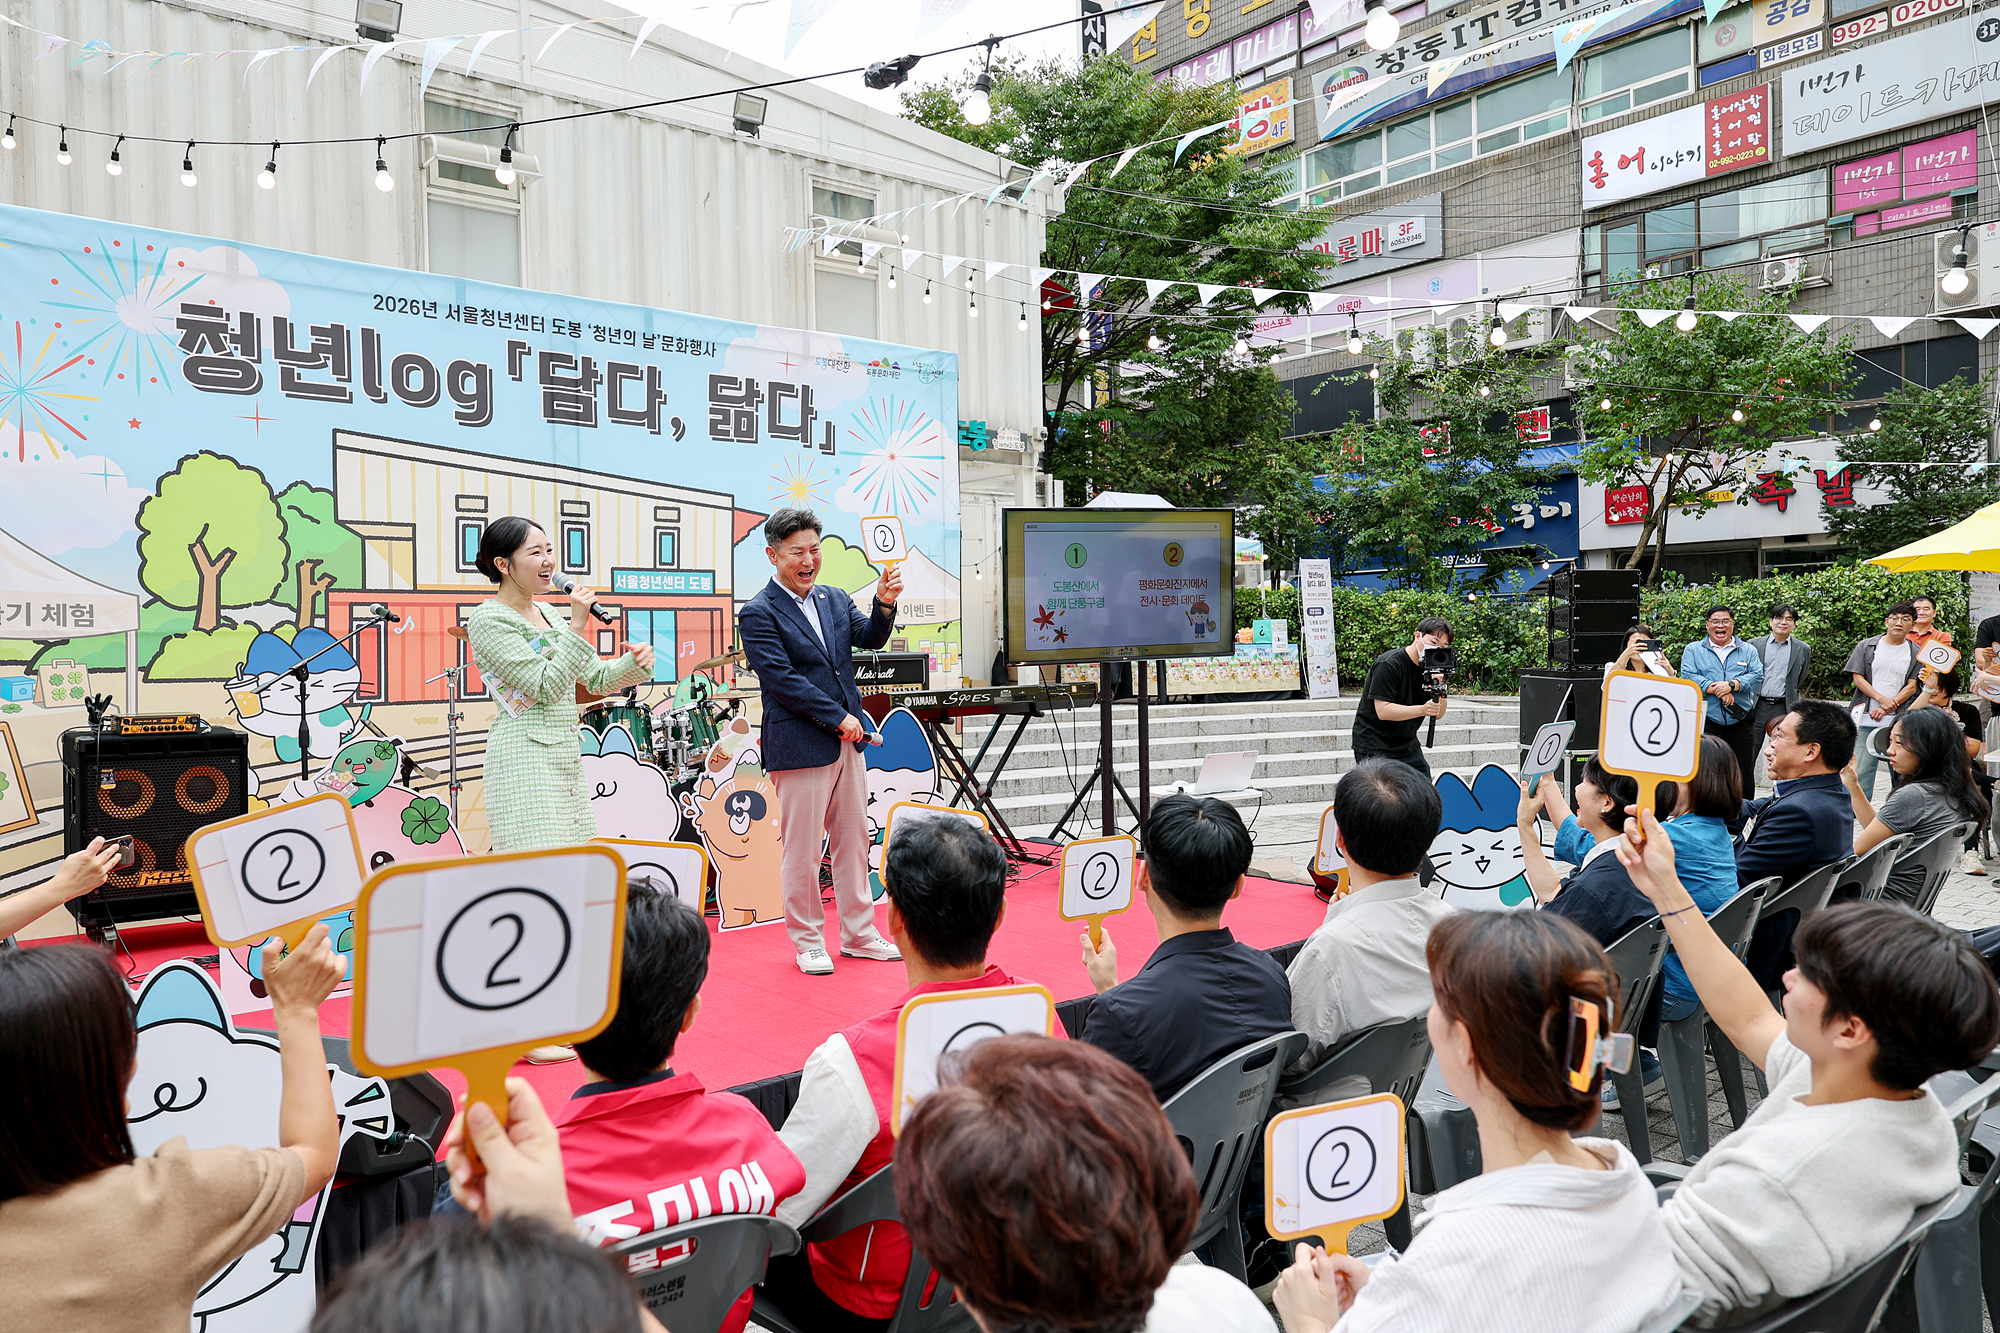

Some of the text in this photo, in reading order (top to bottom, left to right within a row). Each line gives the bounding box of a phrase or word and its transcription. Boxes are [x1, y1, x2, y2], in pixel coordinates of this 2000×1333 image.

[1896, 0, 1958, 21] 020
[1763, 34, 1819, 62] 회원모집
[1326, 74, 1365, 93] COMPUTER
[1792, 60, 2000, 136] 데이트카페
[1271, 120, 1286, 138] 4F
[1650, 145, 1701, 172] 이야기
[1708, 149, 1754, 168] 02-992-0223
[1398, 221, 1414, 237] 3F
[1390, 233, 1422, 247] 6052.9345
[1336, 298, 1362, 313] 아로마
[373, 293, 438, 320] 2026년
[445, 303, 545, 334] 서울청년센터
[552, 320, 582, 340] 도봉
[175, 301, 494, 428] 청년log
[866, 368, 901, 380] 도봉문화재단
[615, 574, 711, 591] 서울청년센터 도봉
[1053, 580, 1099, 593] 도봉산에서
[1138, 578, 1208, 591] 평화문화진지에서
[1047, 597, 1105, 610] 함께 단풍구경
[1181, 594, 1206, 605] 데이트
[0, 602, 95, 628] 기 체험
[903, 603, 936, 618] 이벤트
[911, 694, 938, 706] YAMAHA
